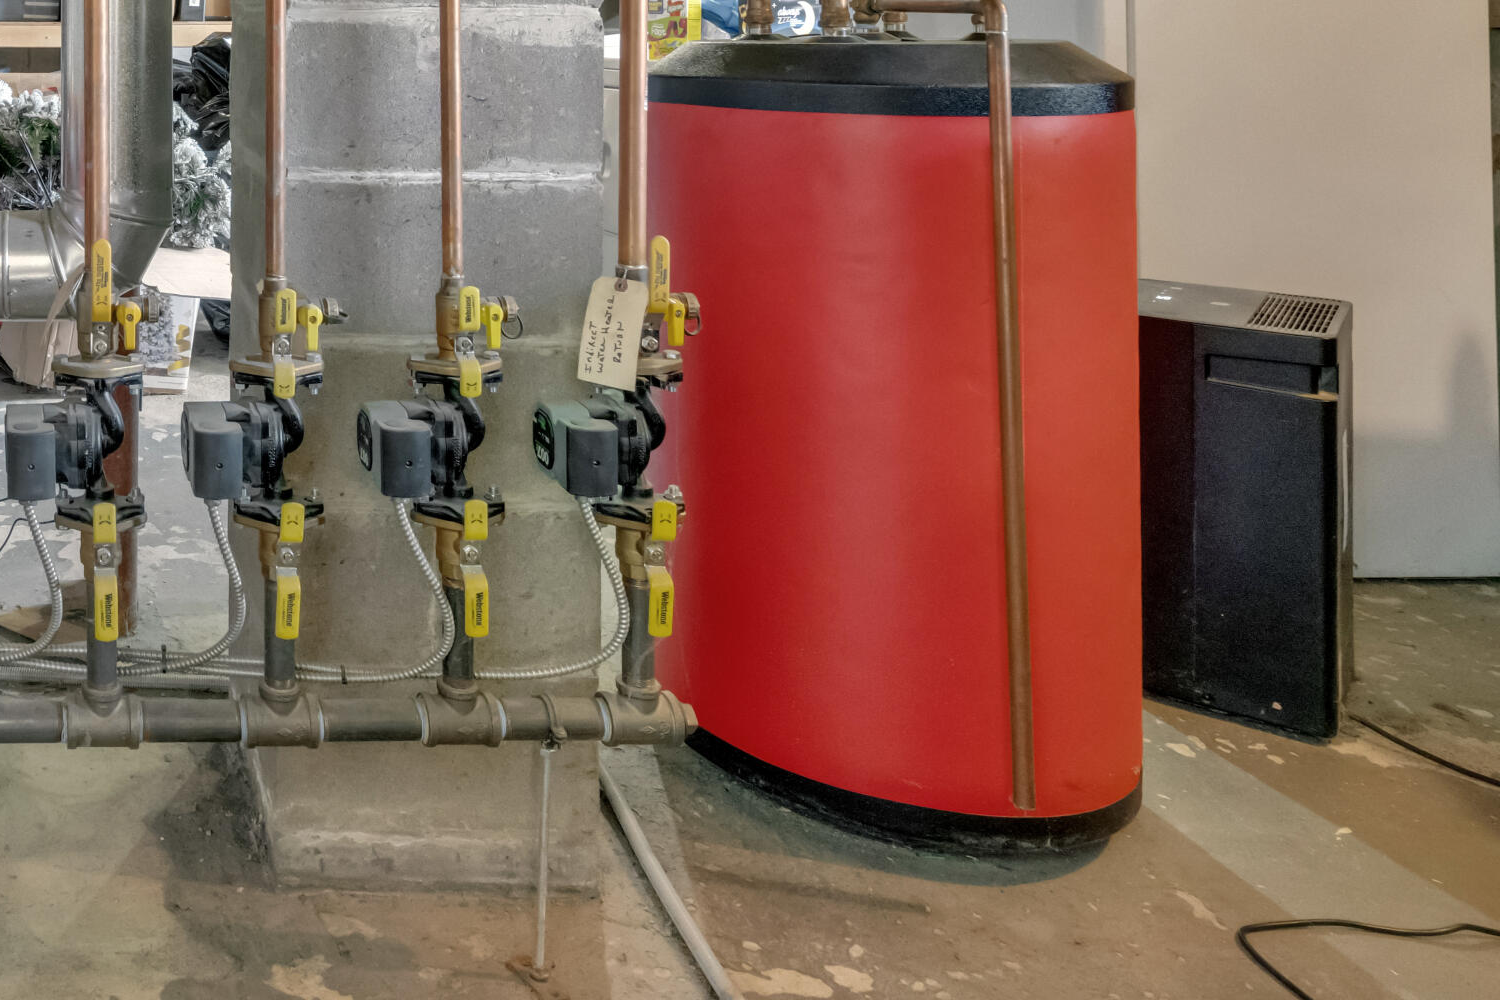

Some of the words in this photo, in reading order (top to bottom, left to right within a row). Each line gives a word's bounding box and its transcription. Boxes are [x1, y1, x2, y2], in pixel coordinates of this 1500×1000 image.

[104, 592, 113, 628] Webstone
[285, 591, 296, 628] Webstone
[475, 590, 484, 627] Webstone
[660, 590, 670, 625] Webstone
